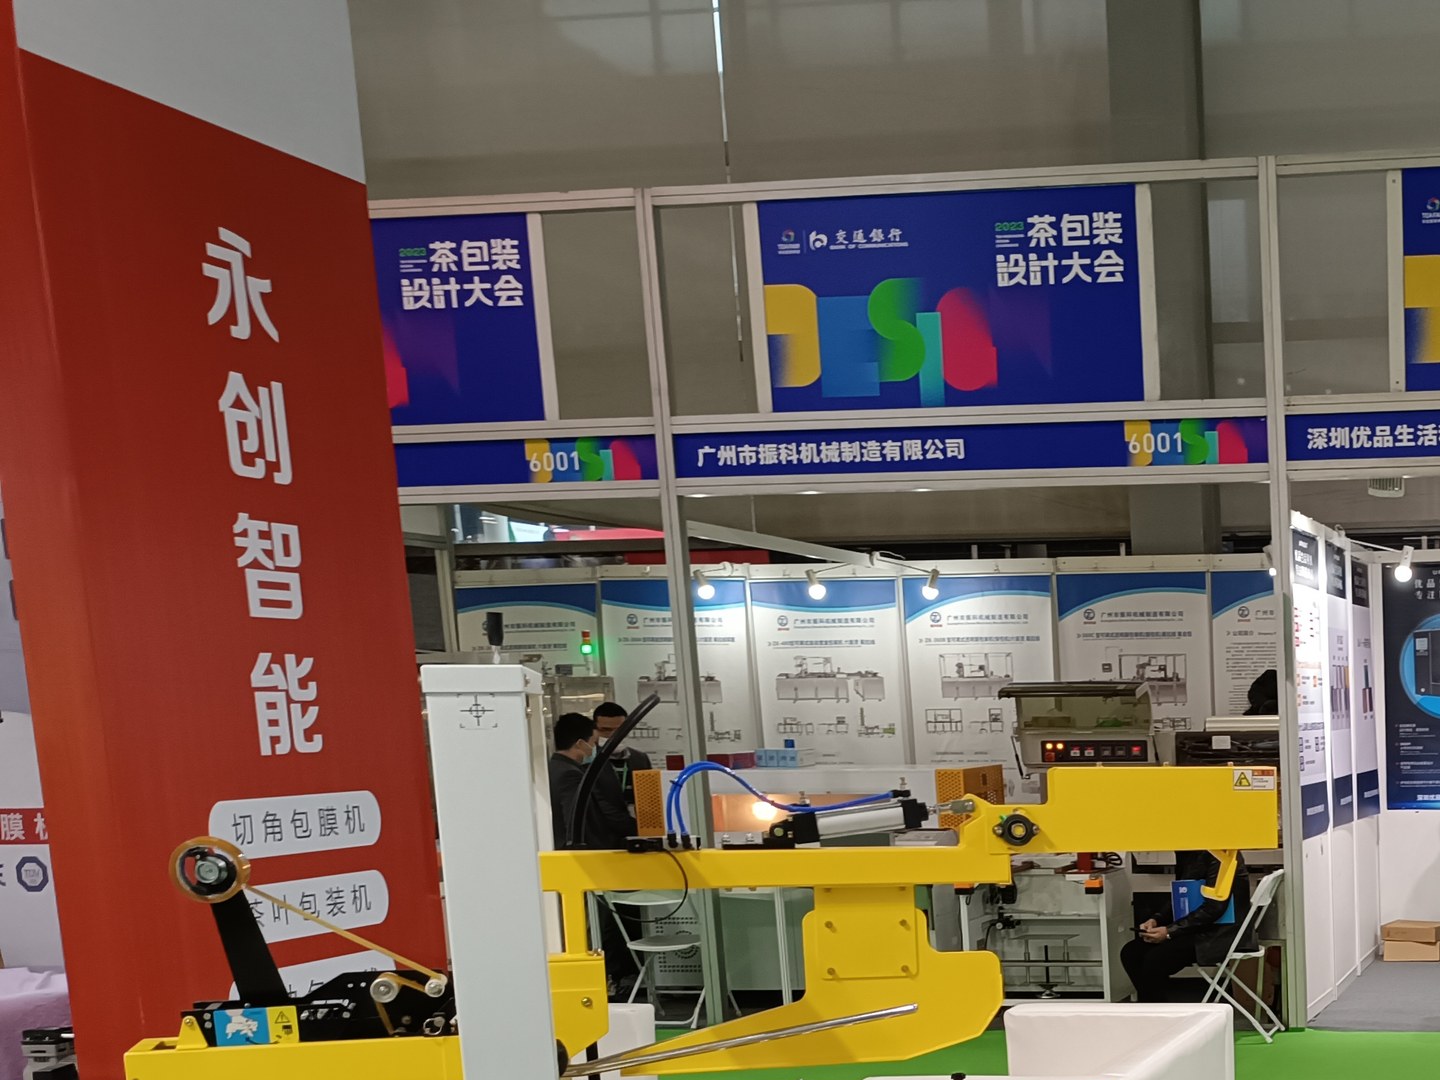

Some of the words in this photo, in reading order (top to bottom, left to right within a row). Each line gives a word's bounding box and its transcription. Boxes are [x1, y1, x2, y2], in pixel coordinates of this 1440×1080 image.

[994, 221, 1025, 232] 2023
[1026, 211, 1123, 247] 茶包装
[428, 238, 521, 272] 茶包装
[996, 249, 1124, 287] 設計大会
[400, 274, 524, 310] 設計大会
[697, 438, 966, 468] 广州市振科机械制造有限公司
[1128, 431, 1183, 455] 6001
[529, 451, 581, 473] 6001
[202, 226, 323, 757] 永创智能
[232, 804, 365, 846] 切角包膜机
